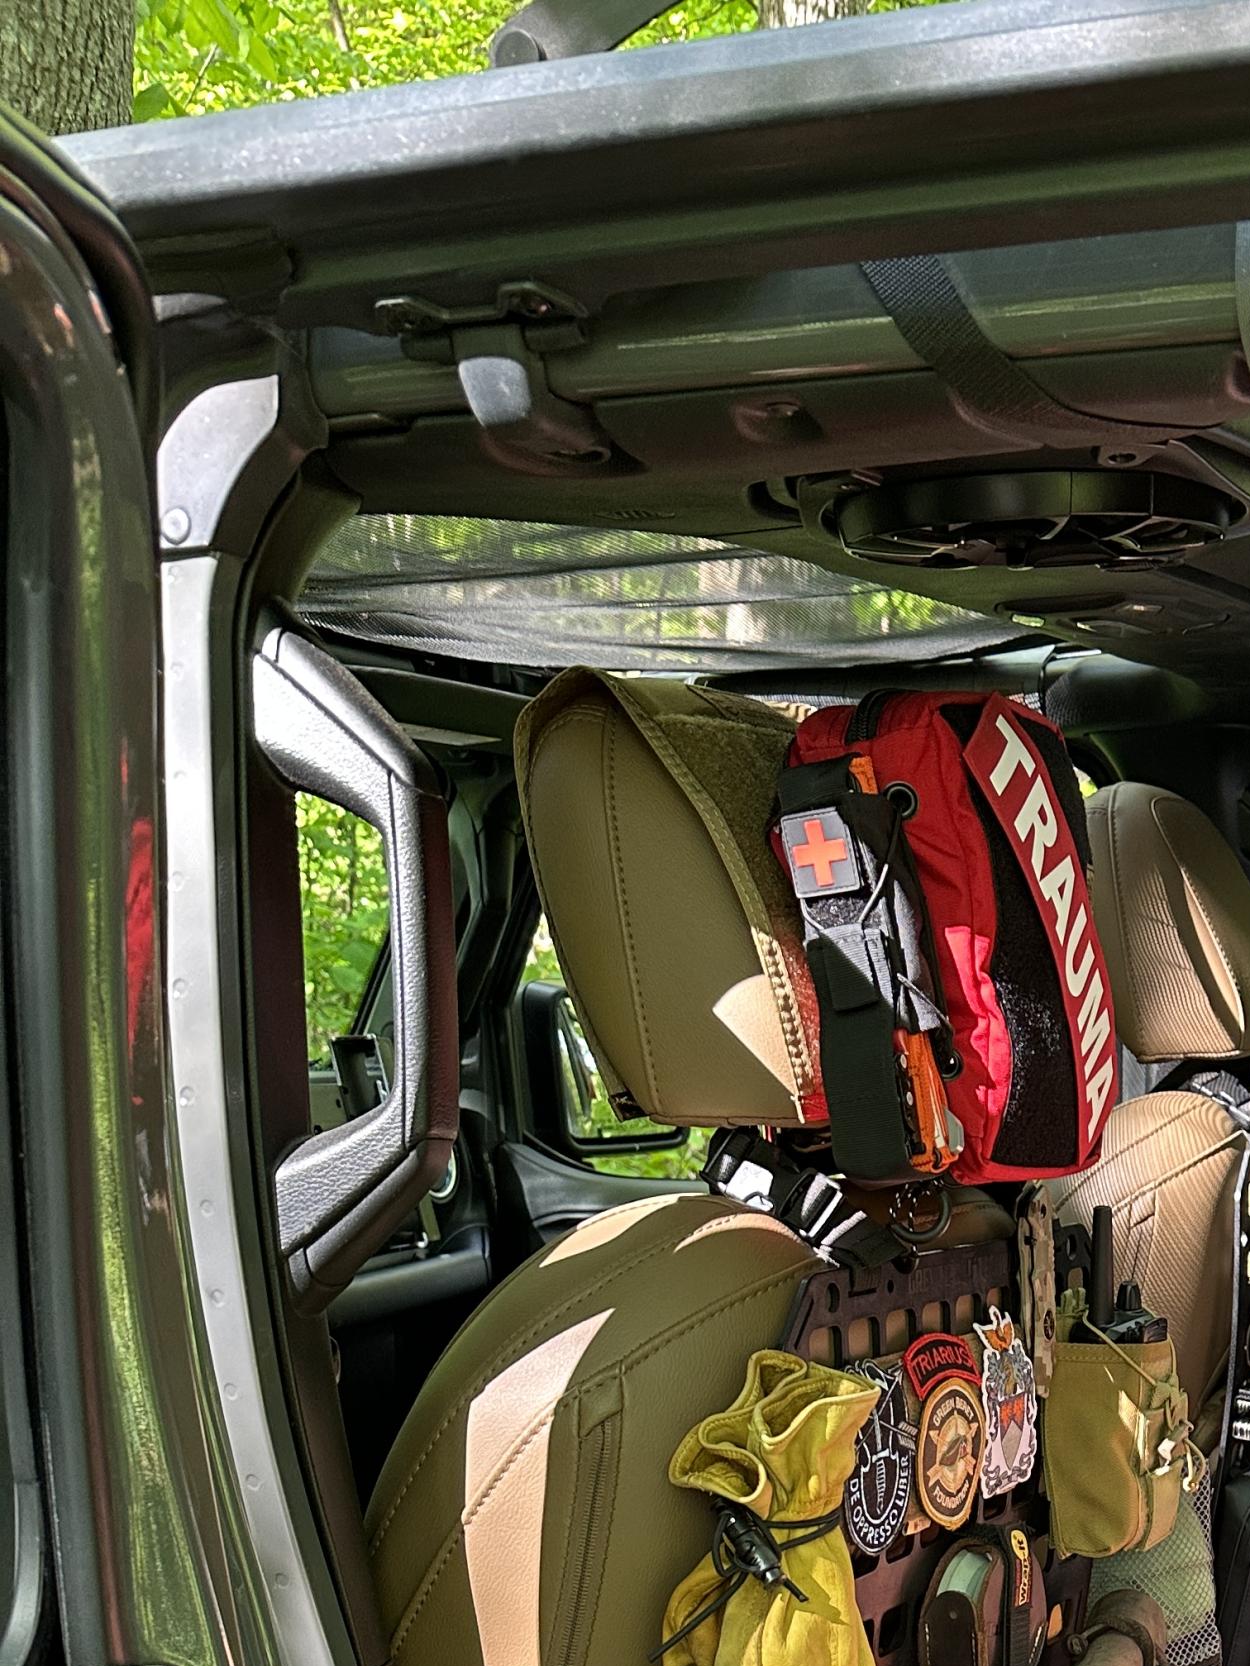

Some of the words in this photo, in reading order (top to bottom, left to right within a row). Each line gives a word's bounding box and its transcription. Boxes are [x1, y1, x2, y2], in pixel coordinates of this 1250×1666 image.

[989, 714, 1115, 1143] TRAUMA
[911, 1346, 972, 1379] TRIARIUS
[933, 1396, 955, 1426] GREEN
[955, 1395, 975, 1420] BERET
[850, 1478, 860, 1506] DE
[895, 1455, 909, 1507] LIBER
[932, 1480, 970, 1510] FOUNDATION
[853, 1506, 898, 1545] OPPRESSO
